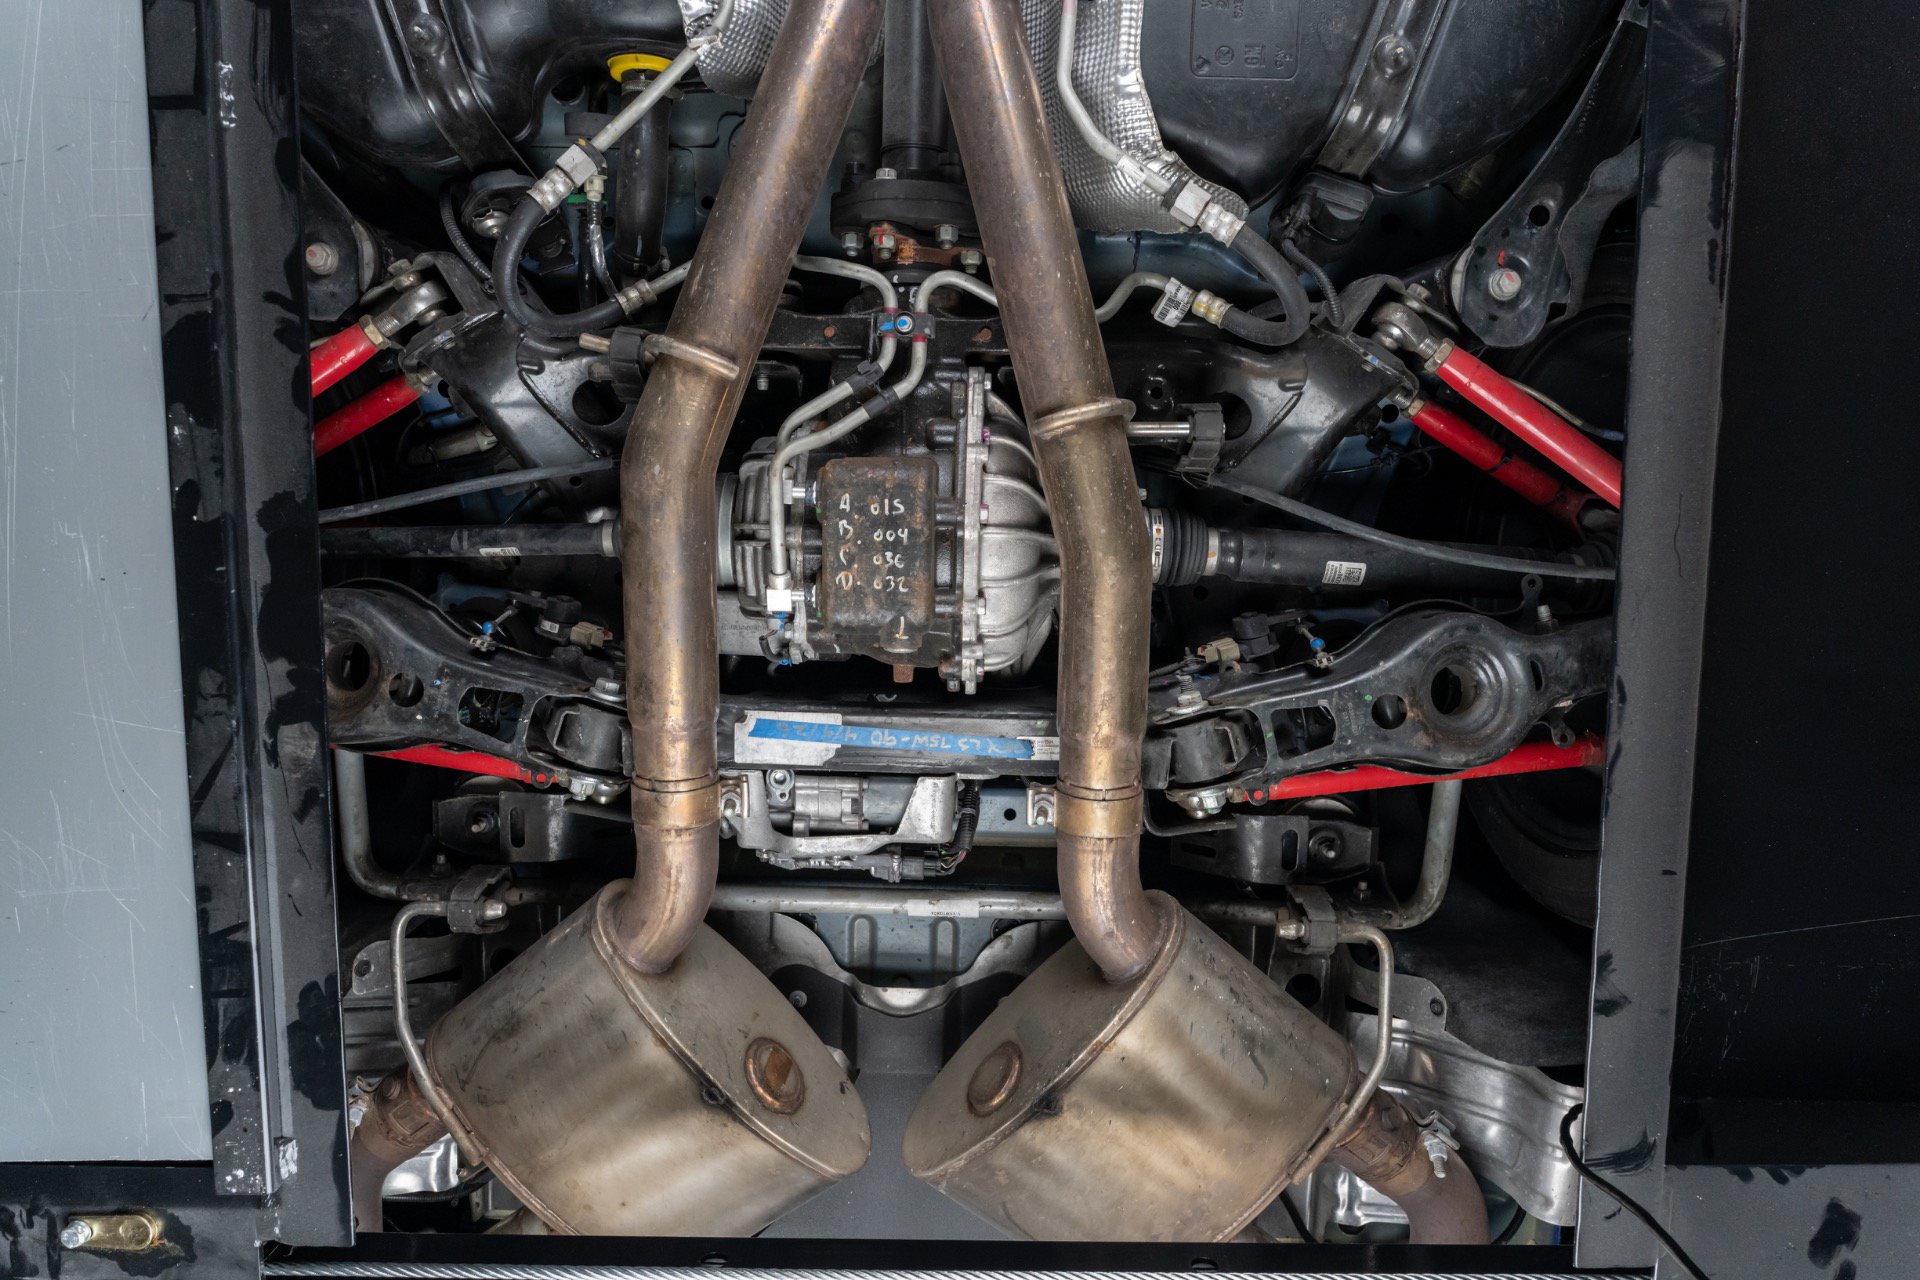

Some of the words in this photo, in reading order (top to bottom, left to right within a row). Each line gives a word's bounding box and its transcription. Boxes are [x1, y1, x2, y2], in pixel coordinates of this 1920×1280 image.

[873, 527, 909, 545] 004
[873, 551, 905, 569] 036
[873, 575, 909, 593] 032
